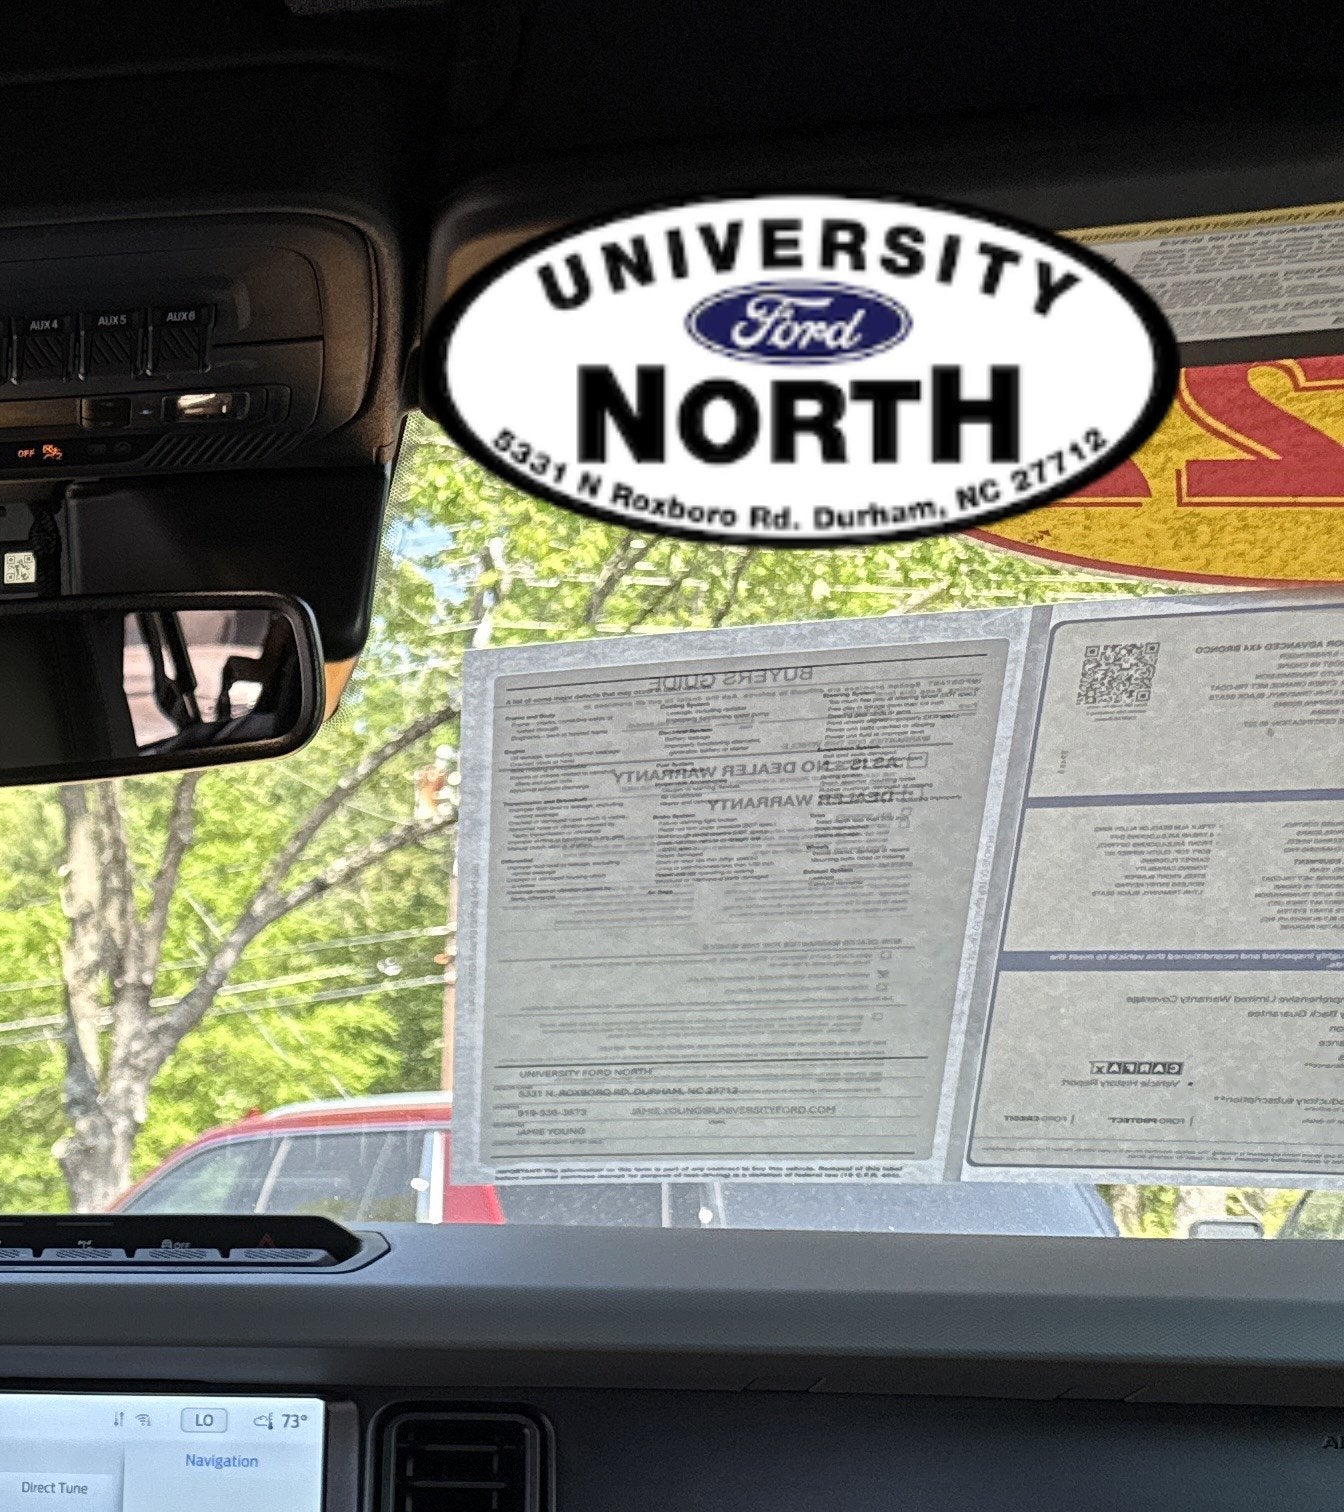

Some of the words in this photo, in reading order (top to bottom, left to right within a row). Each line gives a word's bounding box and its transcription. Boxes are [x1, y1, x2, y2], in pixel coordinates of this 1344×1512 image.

[17, 449, 35, 459] OFF
[519, 1069, 580, 1079] UNIVERSITY
[582, 1068, 611, 1078] FORD
[195, 1414, 214, 1427] LO
[281, 1413, 308, 1428] 73°
[185, 1453, 258, 1470] Navigation
[21, 1481, 56, 1495] Direct
[58, 1482, 88, 1495] Tune
